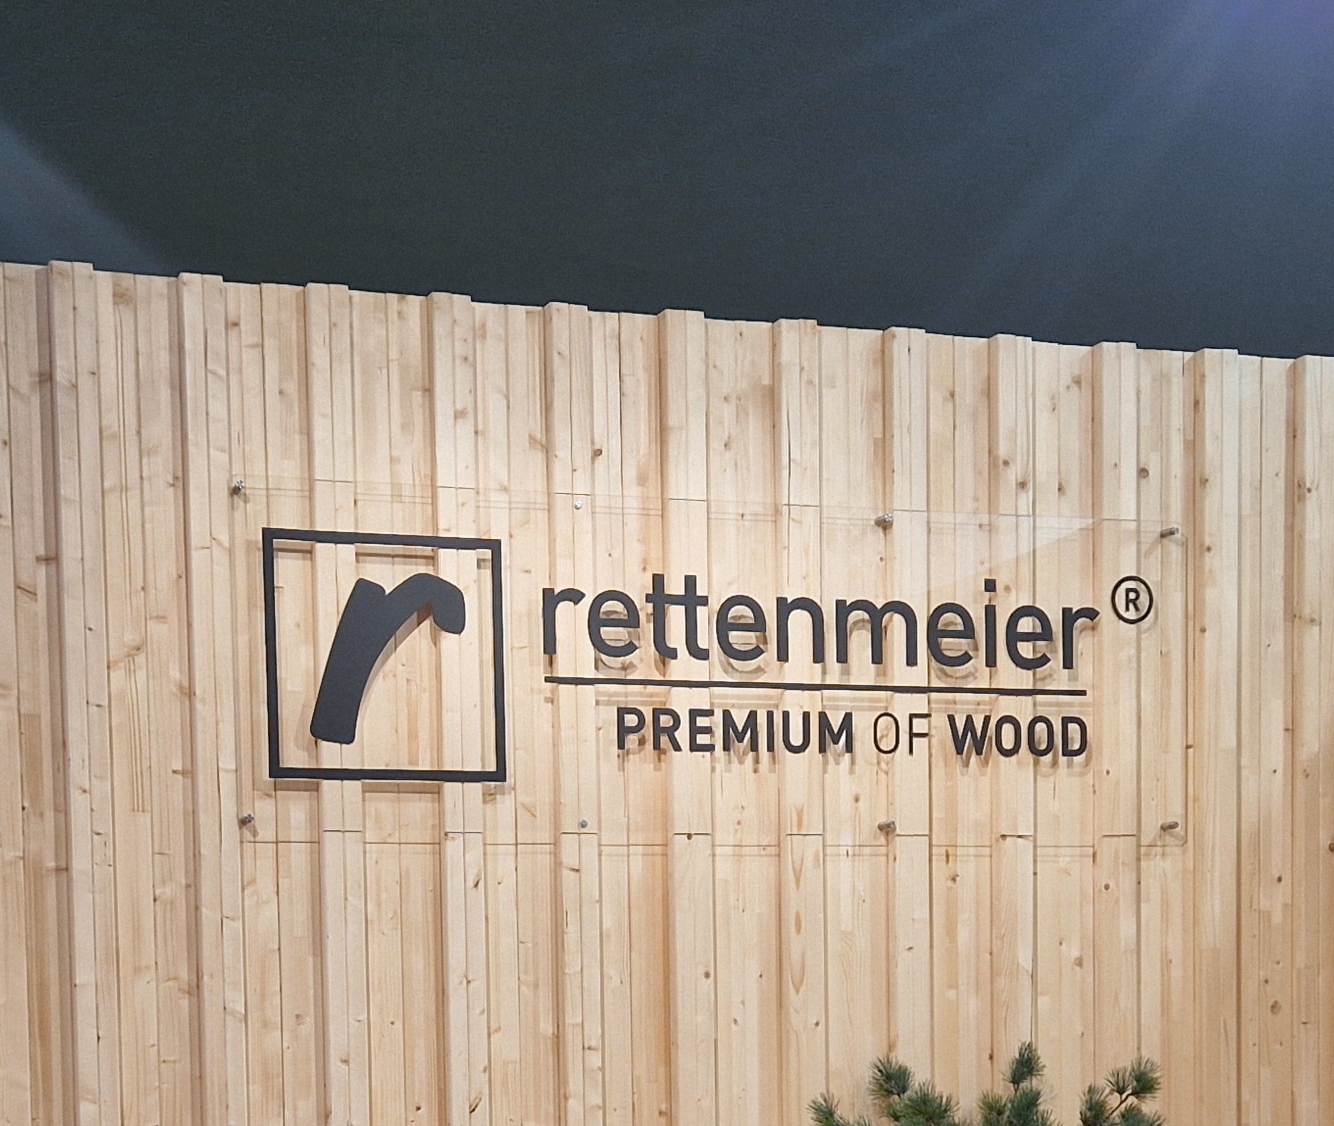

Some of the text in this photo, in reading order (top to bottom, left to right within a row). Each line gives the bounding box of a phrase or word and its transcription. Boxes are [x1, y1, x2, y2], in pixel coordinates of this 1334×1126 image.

[616, 706, 1089, 758] PREMIUM OF WOOD
